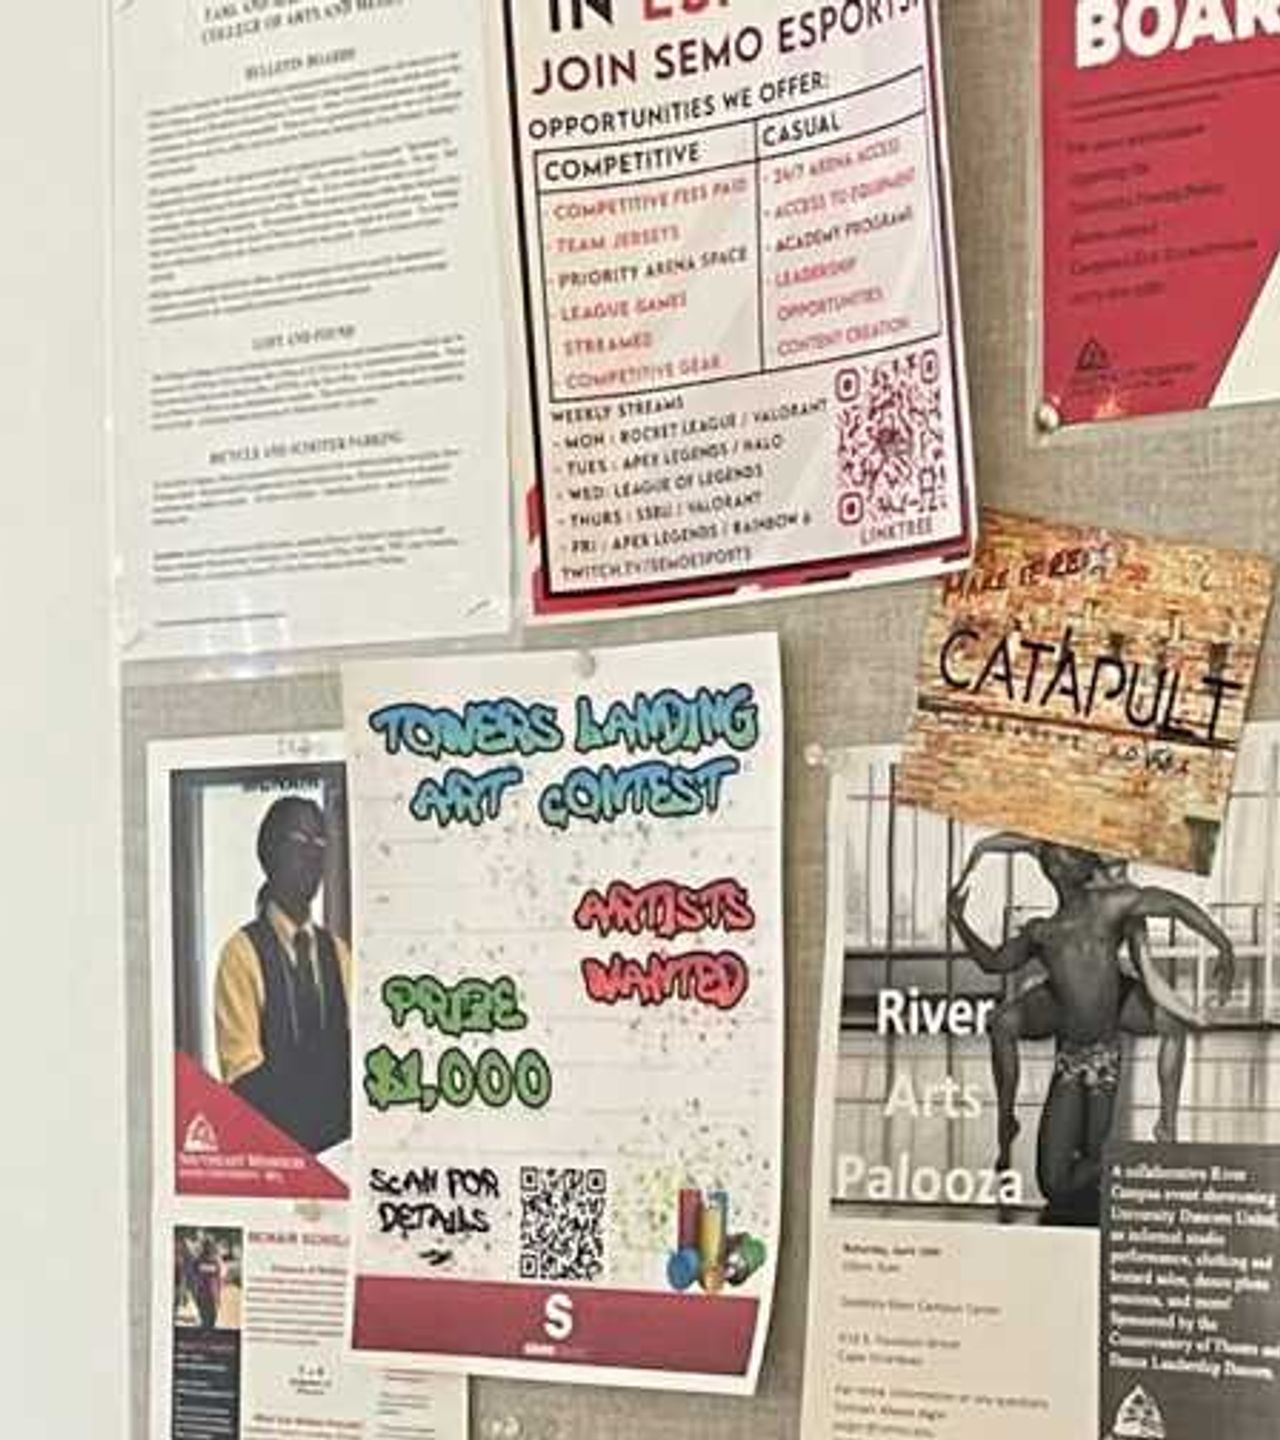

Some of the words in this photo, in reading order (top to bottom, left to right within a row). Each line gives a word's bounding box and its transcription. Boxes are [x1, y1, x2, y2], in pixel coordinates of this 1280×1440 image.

[530, 50, 638, 96] JOIN
[654, 26, 762, 80] SEMO
[528, 95, 716, 140] OPPORTUNITIES
[721, 86, 753, 109] WE
[759, 71, 830, 102] OFFER:
[760, 112, 842, 147] CASUAL
[544, 141, 701, 181] COMPETITIVE
[552, 191, 668, 220] COMPETITIVE
[711, 177, 748, 201] PAID
[556, 234, 606, 254] TEAM
[558, 266, 641, 290] PRIORITY
[645, 256, 696, 278] ARENA
[699, 246, 749, 270] SPACE
[561, 301, 630, 323] LEAGUE
[634, 291, 688, 316] GAMES
[679, 354, 722, 373] GEAR
[551, 405, 613, 424] WEEKLY
[617, 396, 685, 417] STREAMS
[620, 425, 678, 446] ROCKET
[680, 415, 737, 438] LEAGUE
[664, 443, 728, 466] LEGENDS
[939, 622, 1244, 741] CATAPULT
[369, 696, 564, 761] TOWERS
[574, 681, 760, 754] LANDING
[410, 766, 524, 827] ART
[539, 754, 741, 830] CONTEST
[573, 876, 756, 939] ARTISTS
[581, 950, 749, 1009] WANTED
[381, 973, 528, 1038] PRIZE
[876, 987, 996, 1036] River
[363, 1044, 553, 1112] $1,000
[882, 1073, 983, 1121] Arts
[369, 1166, 439, 1198] SCAN
[448, 1167, 500, 1199] FOR
[835, 1152, 1025, 1203] Palooza
[378, 1202, 491, 1239] DETAILS
[542, 1293, 573, 1340] S
